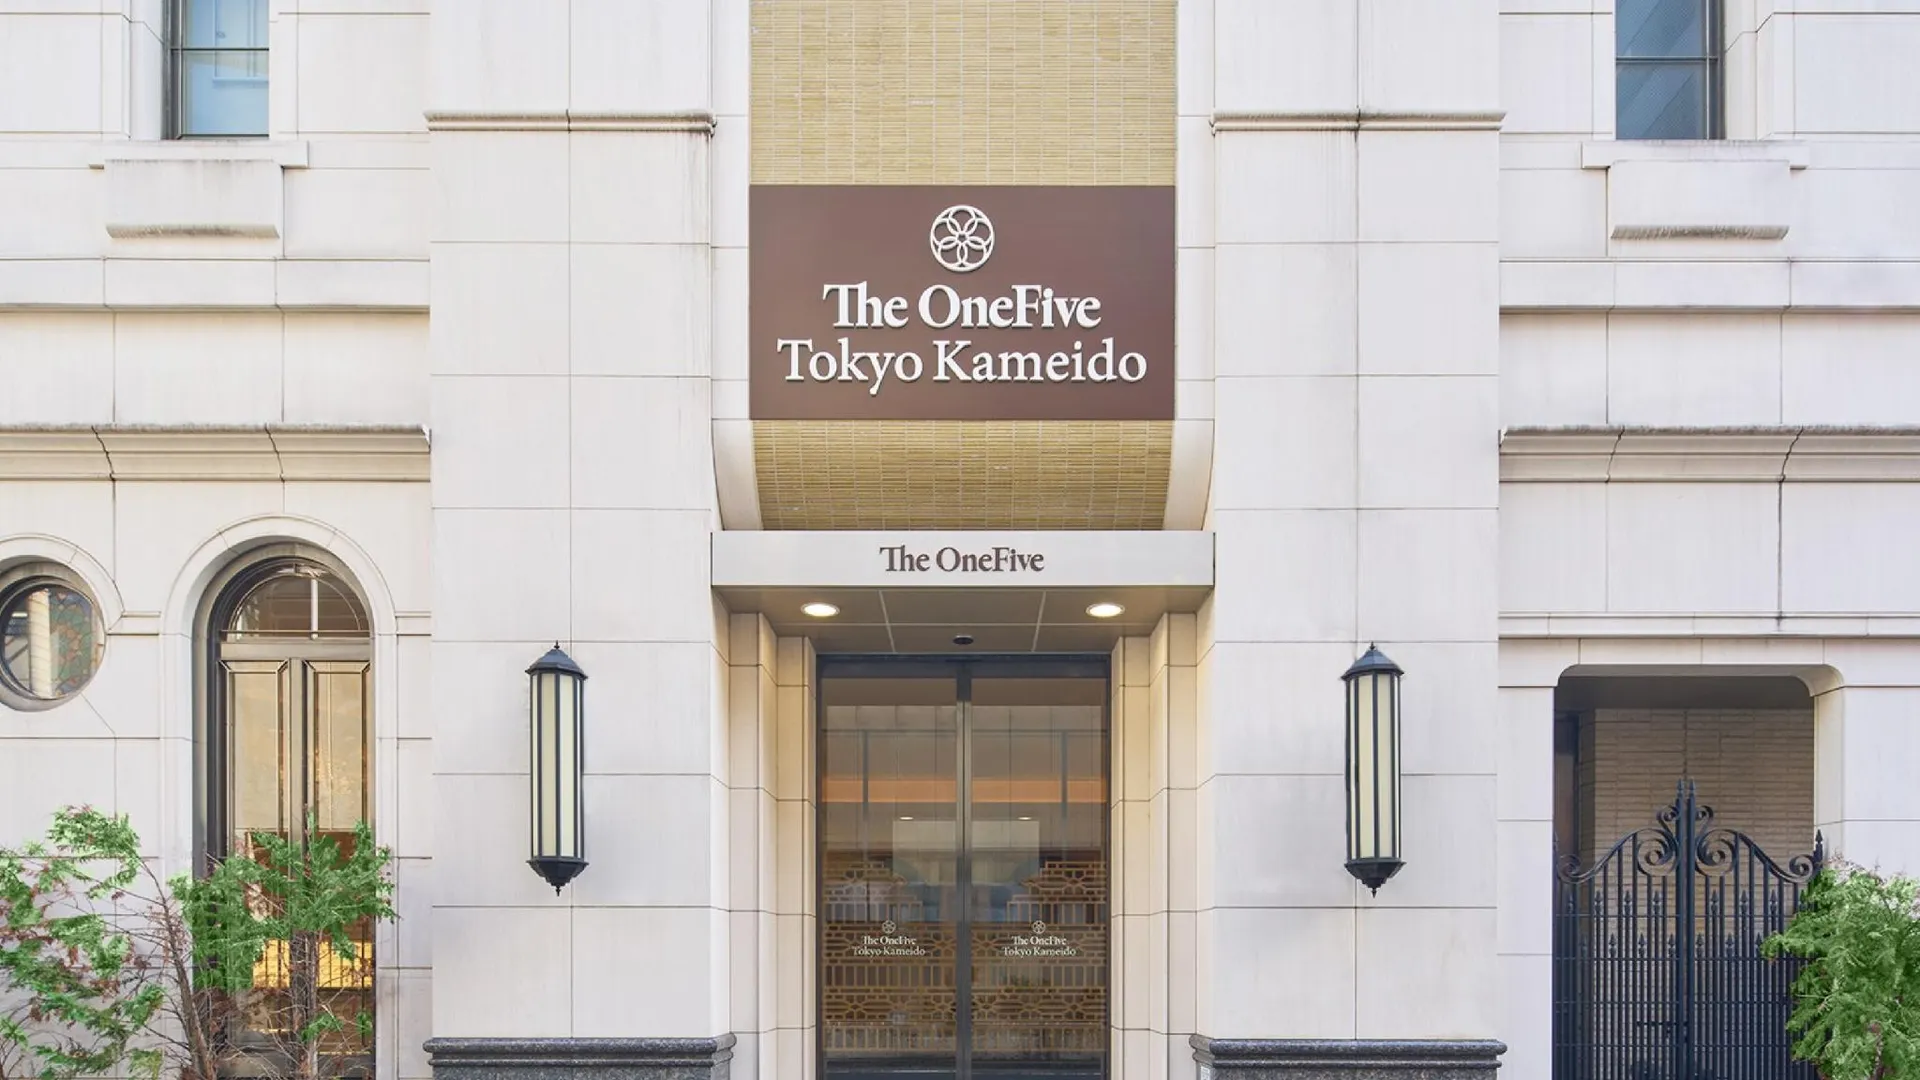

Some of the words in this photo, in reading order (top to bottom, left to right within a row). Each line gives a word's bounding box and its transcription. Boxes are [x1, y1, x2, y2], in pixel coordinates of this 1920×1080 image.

[822, 281, 908, 328] The
[918, 284, 1102, 329] OneFive
[777, 337, 924, 395] Tokyo
[932, 338, 1148, 383] Kameido
[879, 545, 930, 572] The
[936, 546, 1045, 572] OneFive
[1011, 935, 1028, 945] The
[1029, 935, 1067, 945] OneFive
[852, 946, 882, 958] Tokyo
[883, 946, 926, 956] Kameido
[1003, 946, 1032, 958] Tokyo
[1033, 946, 1077, 956] Kameido
